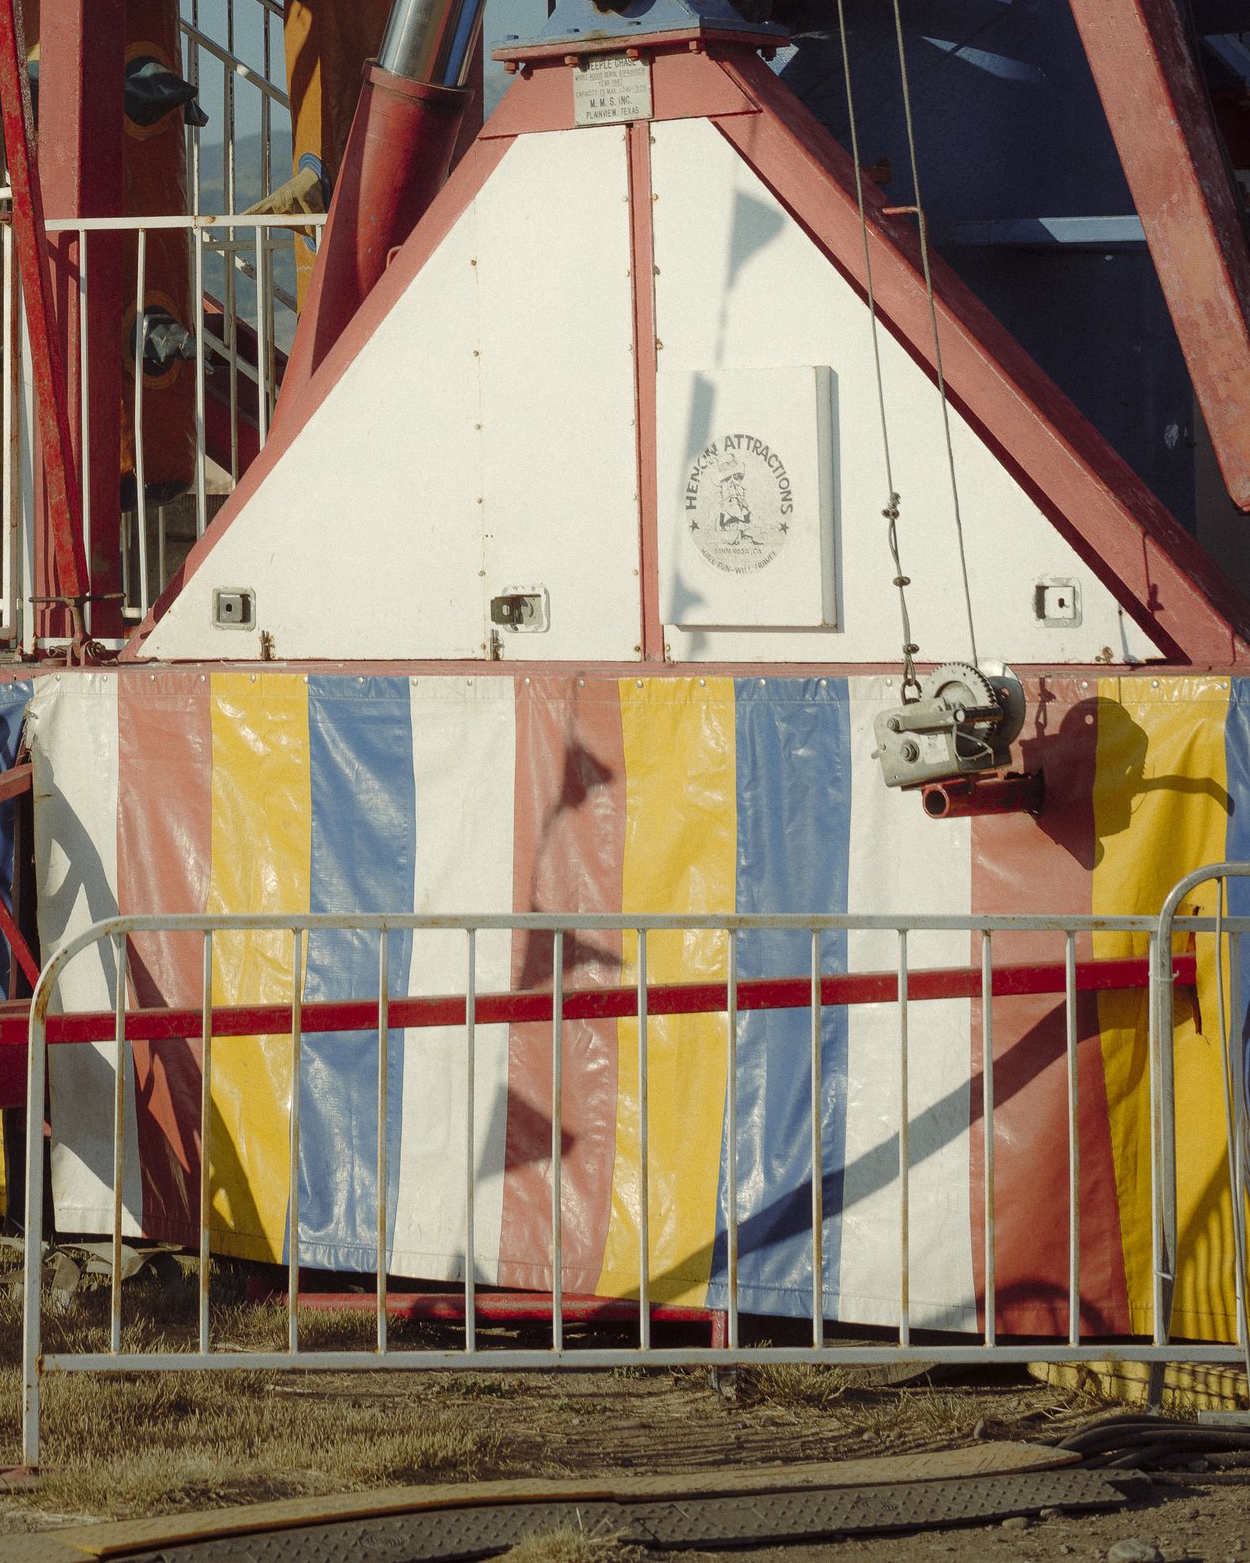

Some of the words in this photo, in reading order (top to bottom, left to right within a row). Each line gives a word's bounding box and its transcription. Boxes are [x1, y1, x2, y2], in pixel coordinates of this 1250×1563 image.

[590, 100, 597, 108] M.
[610, 97, 617, 106] S.
[619, 95, 632, 105] INC.
[621, 106, 639, 115] TEXAS
[724, 434, 793, 515] ATTRACTIONS
